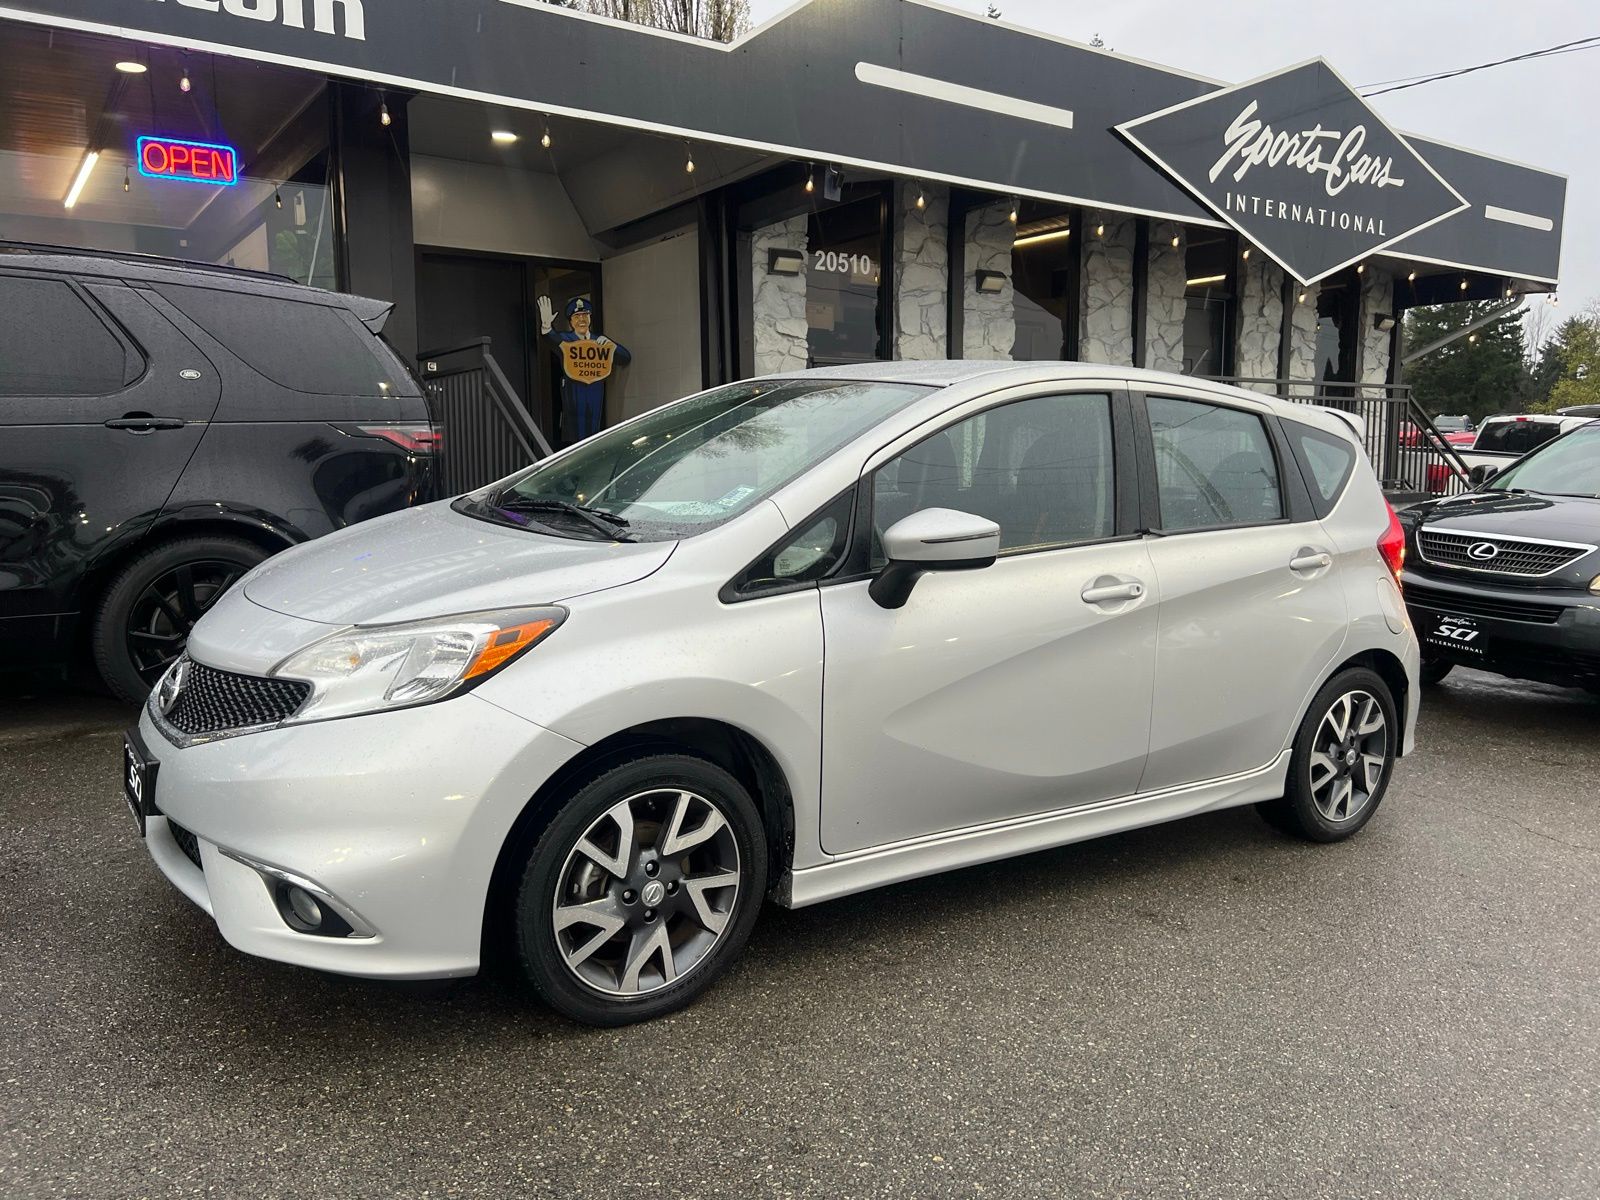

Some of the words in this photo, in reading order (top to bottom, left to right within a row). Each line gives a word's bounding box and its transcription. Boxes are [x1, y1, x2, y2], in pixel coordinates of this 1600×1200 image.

[1209, 99, 1341, 184] Sports
[1325, 124, 1405, 197] Cars
[143, 142, 233, 182] OPEN
[1225, 192, 1386, 236] INTERNATIONAL
[814, 250, 871, 275] 20510
[569, 346, 611, 361] SLOW
[573, 361, 607, 369] SCHOOL
[1433, 625, 1479, 641] SCI
[1426, 637, 1483, 654] INTERNATIONAL
